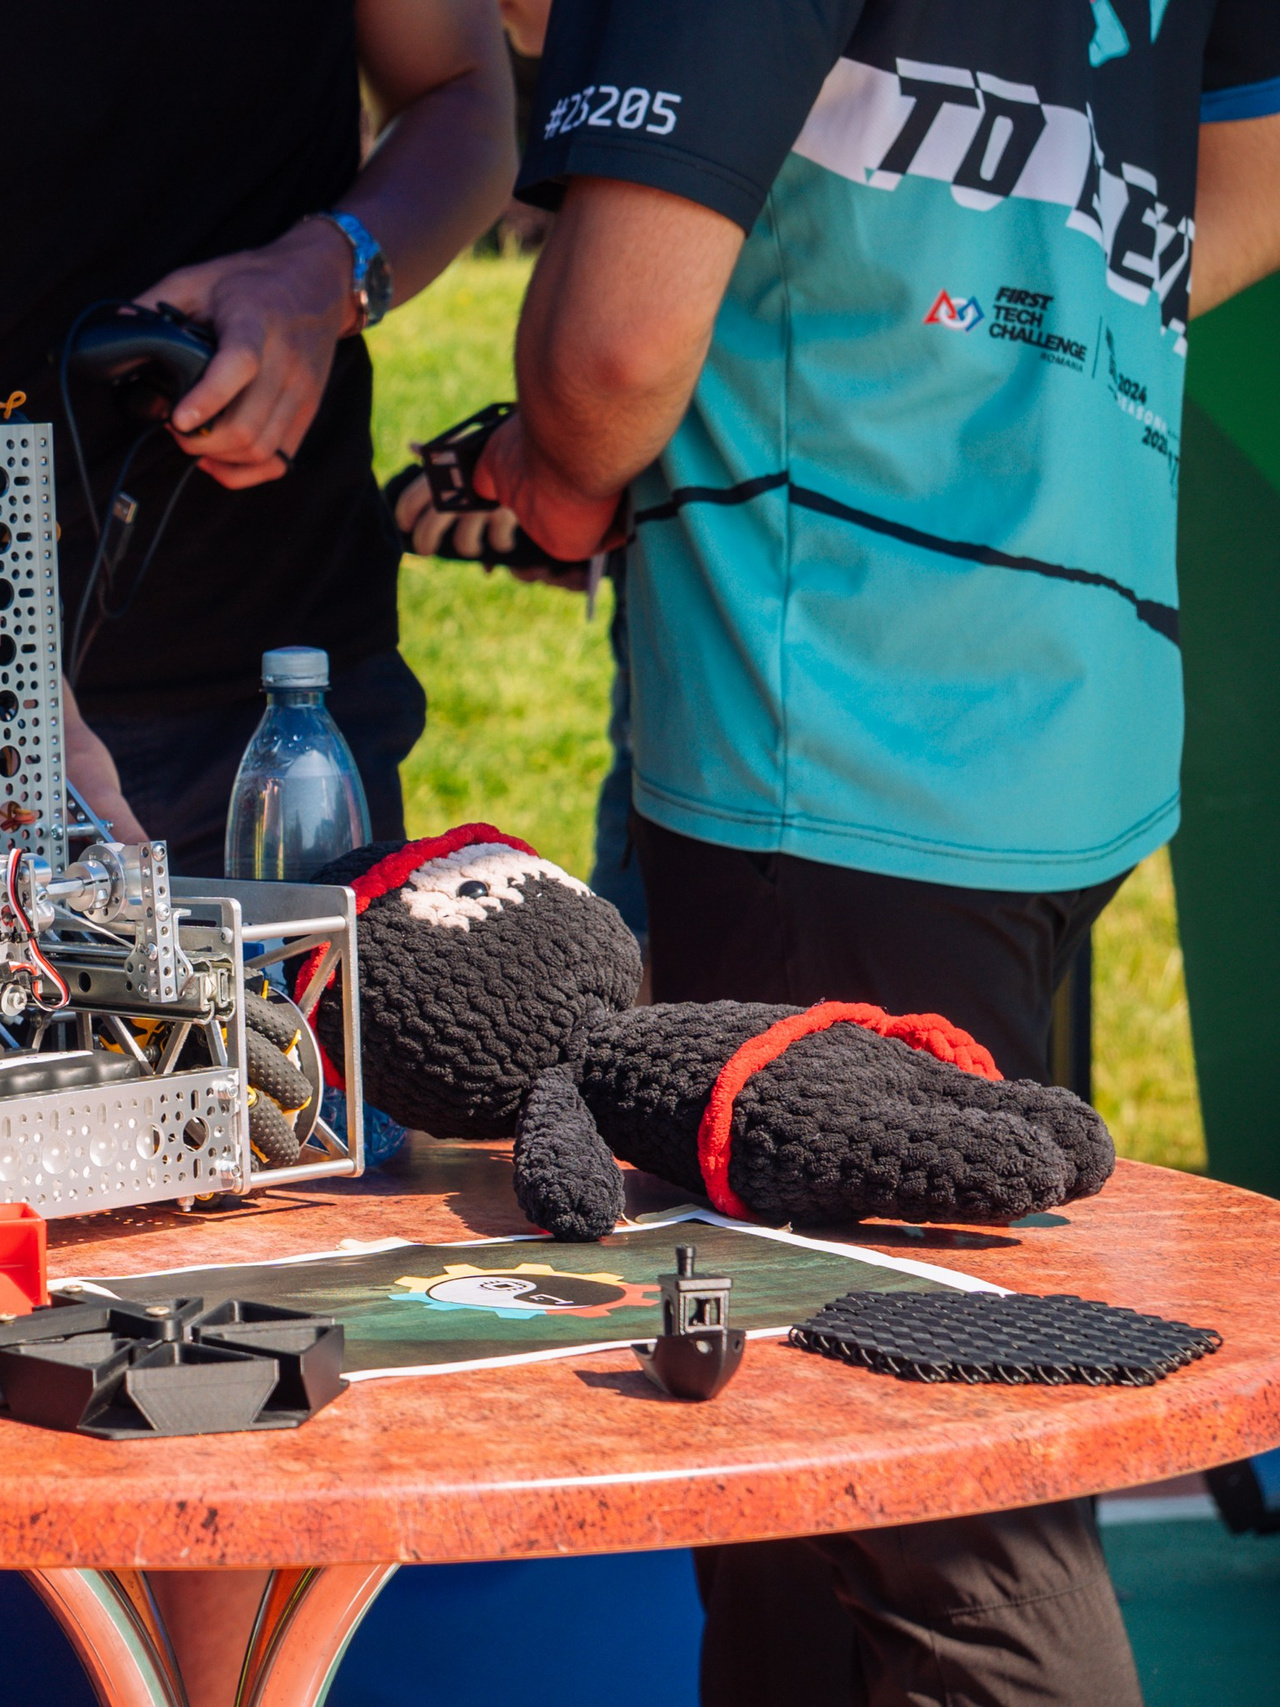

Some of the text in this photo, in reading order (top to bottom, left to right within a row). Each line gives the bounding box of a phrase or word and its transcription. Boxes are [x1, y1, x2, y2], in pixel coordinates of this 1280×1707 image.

[543, 85, 682, 140] #23205
[994, 286, 1054, 311] FIRST
[993, 306, 1044, 328] TECH
[989, 322, 1087, 362] CHALLENGE
[1040, 352, 1084, 373] ROMANIA
[1117, 373, 1147, 405] 2024
